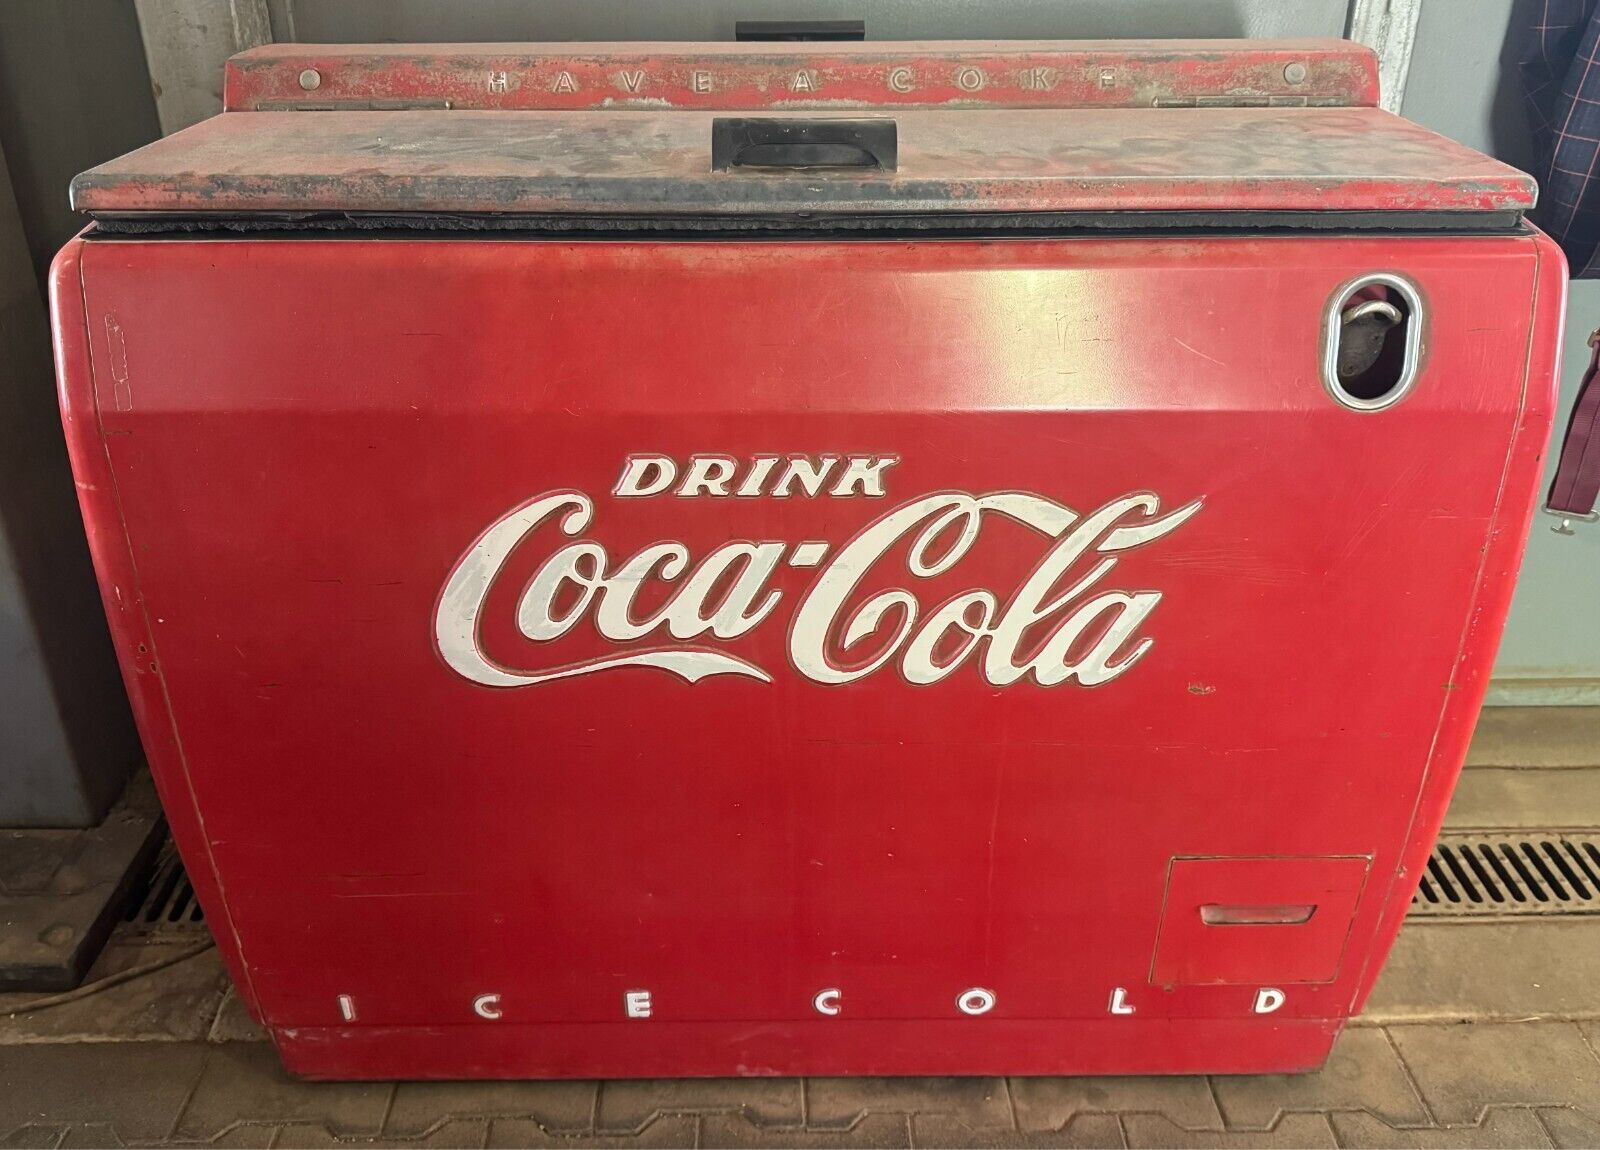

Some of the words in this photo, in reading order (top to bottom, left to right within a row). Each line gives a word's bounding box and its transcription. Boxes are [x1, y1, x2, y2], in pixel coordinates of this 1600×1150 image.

[488, 70, 712, 93] HAVE
[791, 69, 817, 92] A
[890, 67, 1116, 92] COKE
[612, 453, 901, 498] DRINK
[433, 489, 1206, 687] Coca-Cola
[337, 991, 652, 1022] ICE
[812, 987, 1286, 1017] COLD
